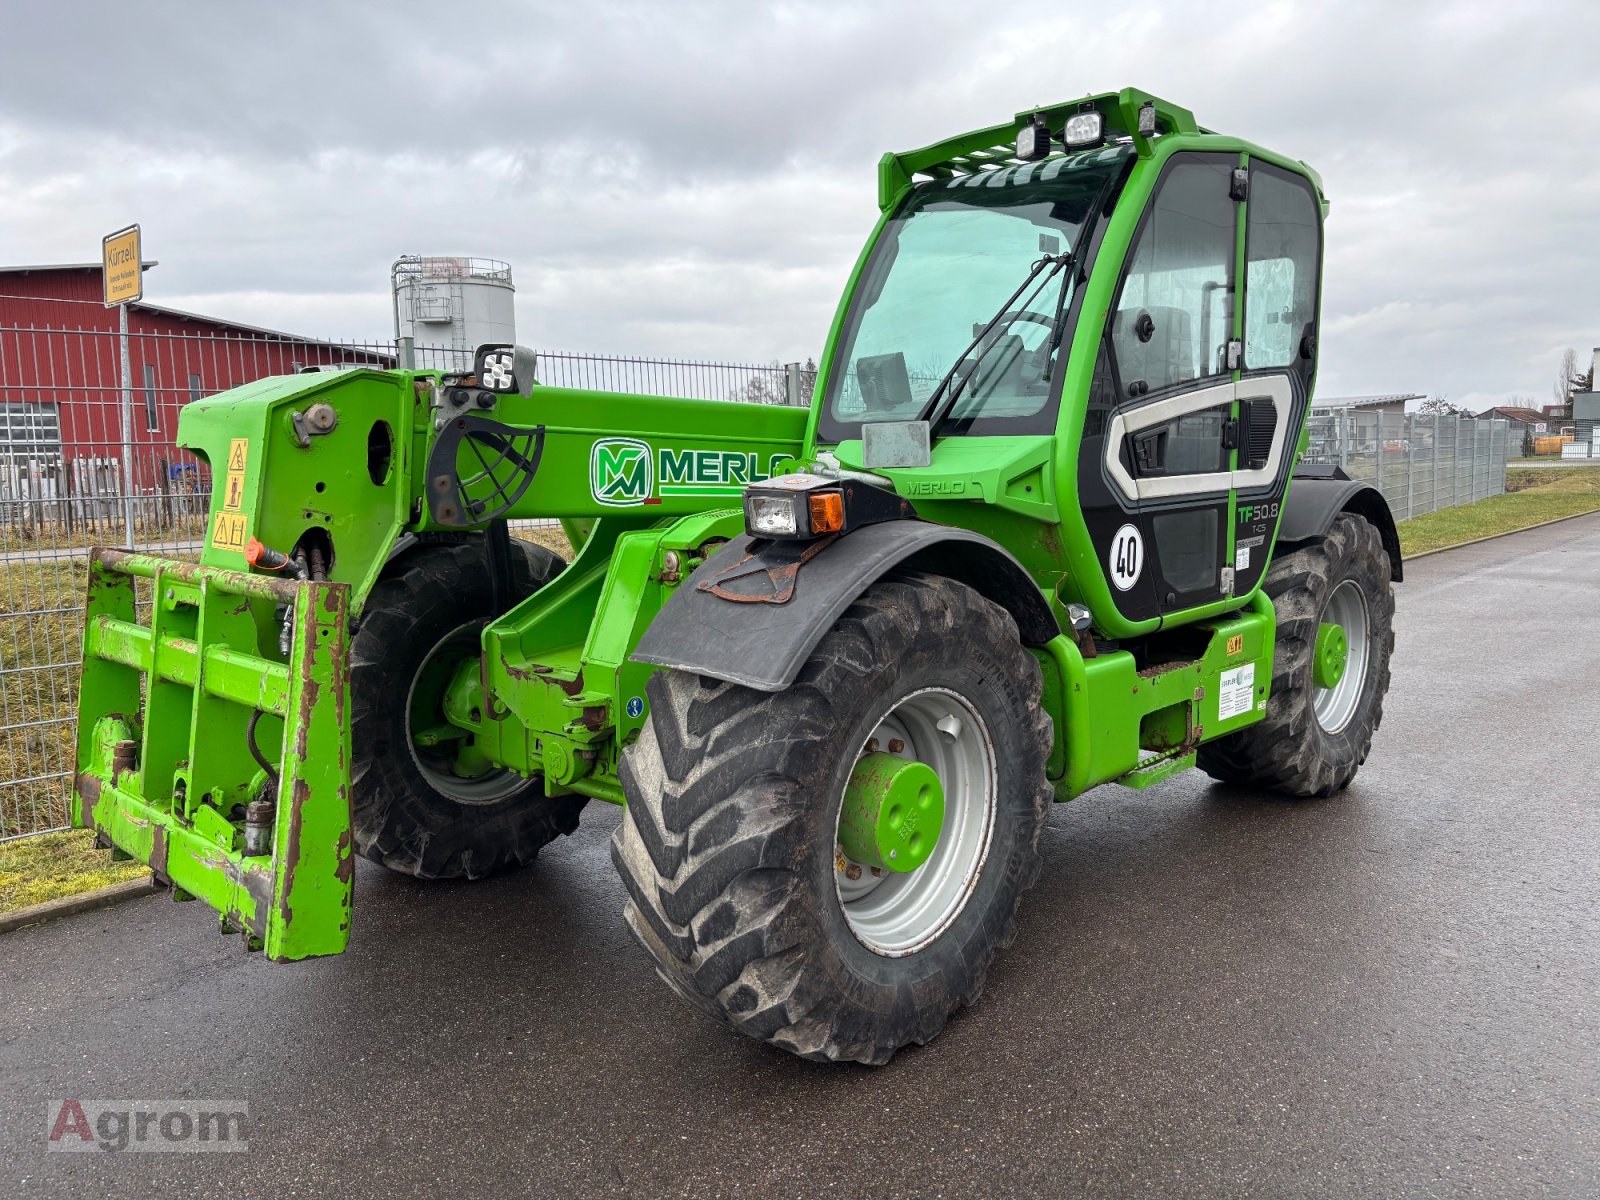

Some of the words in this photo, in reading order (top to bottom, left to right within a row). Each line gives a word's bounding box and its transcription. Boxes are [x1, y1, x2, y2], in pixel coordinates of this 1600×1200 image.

[108, 241, 135, 268] Kürzell
[906, 480, 965, 495] MERLO
[1238, 503, 1279, 524] TF50.8
[1116, 535, 1138, 579] 40
